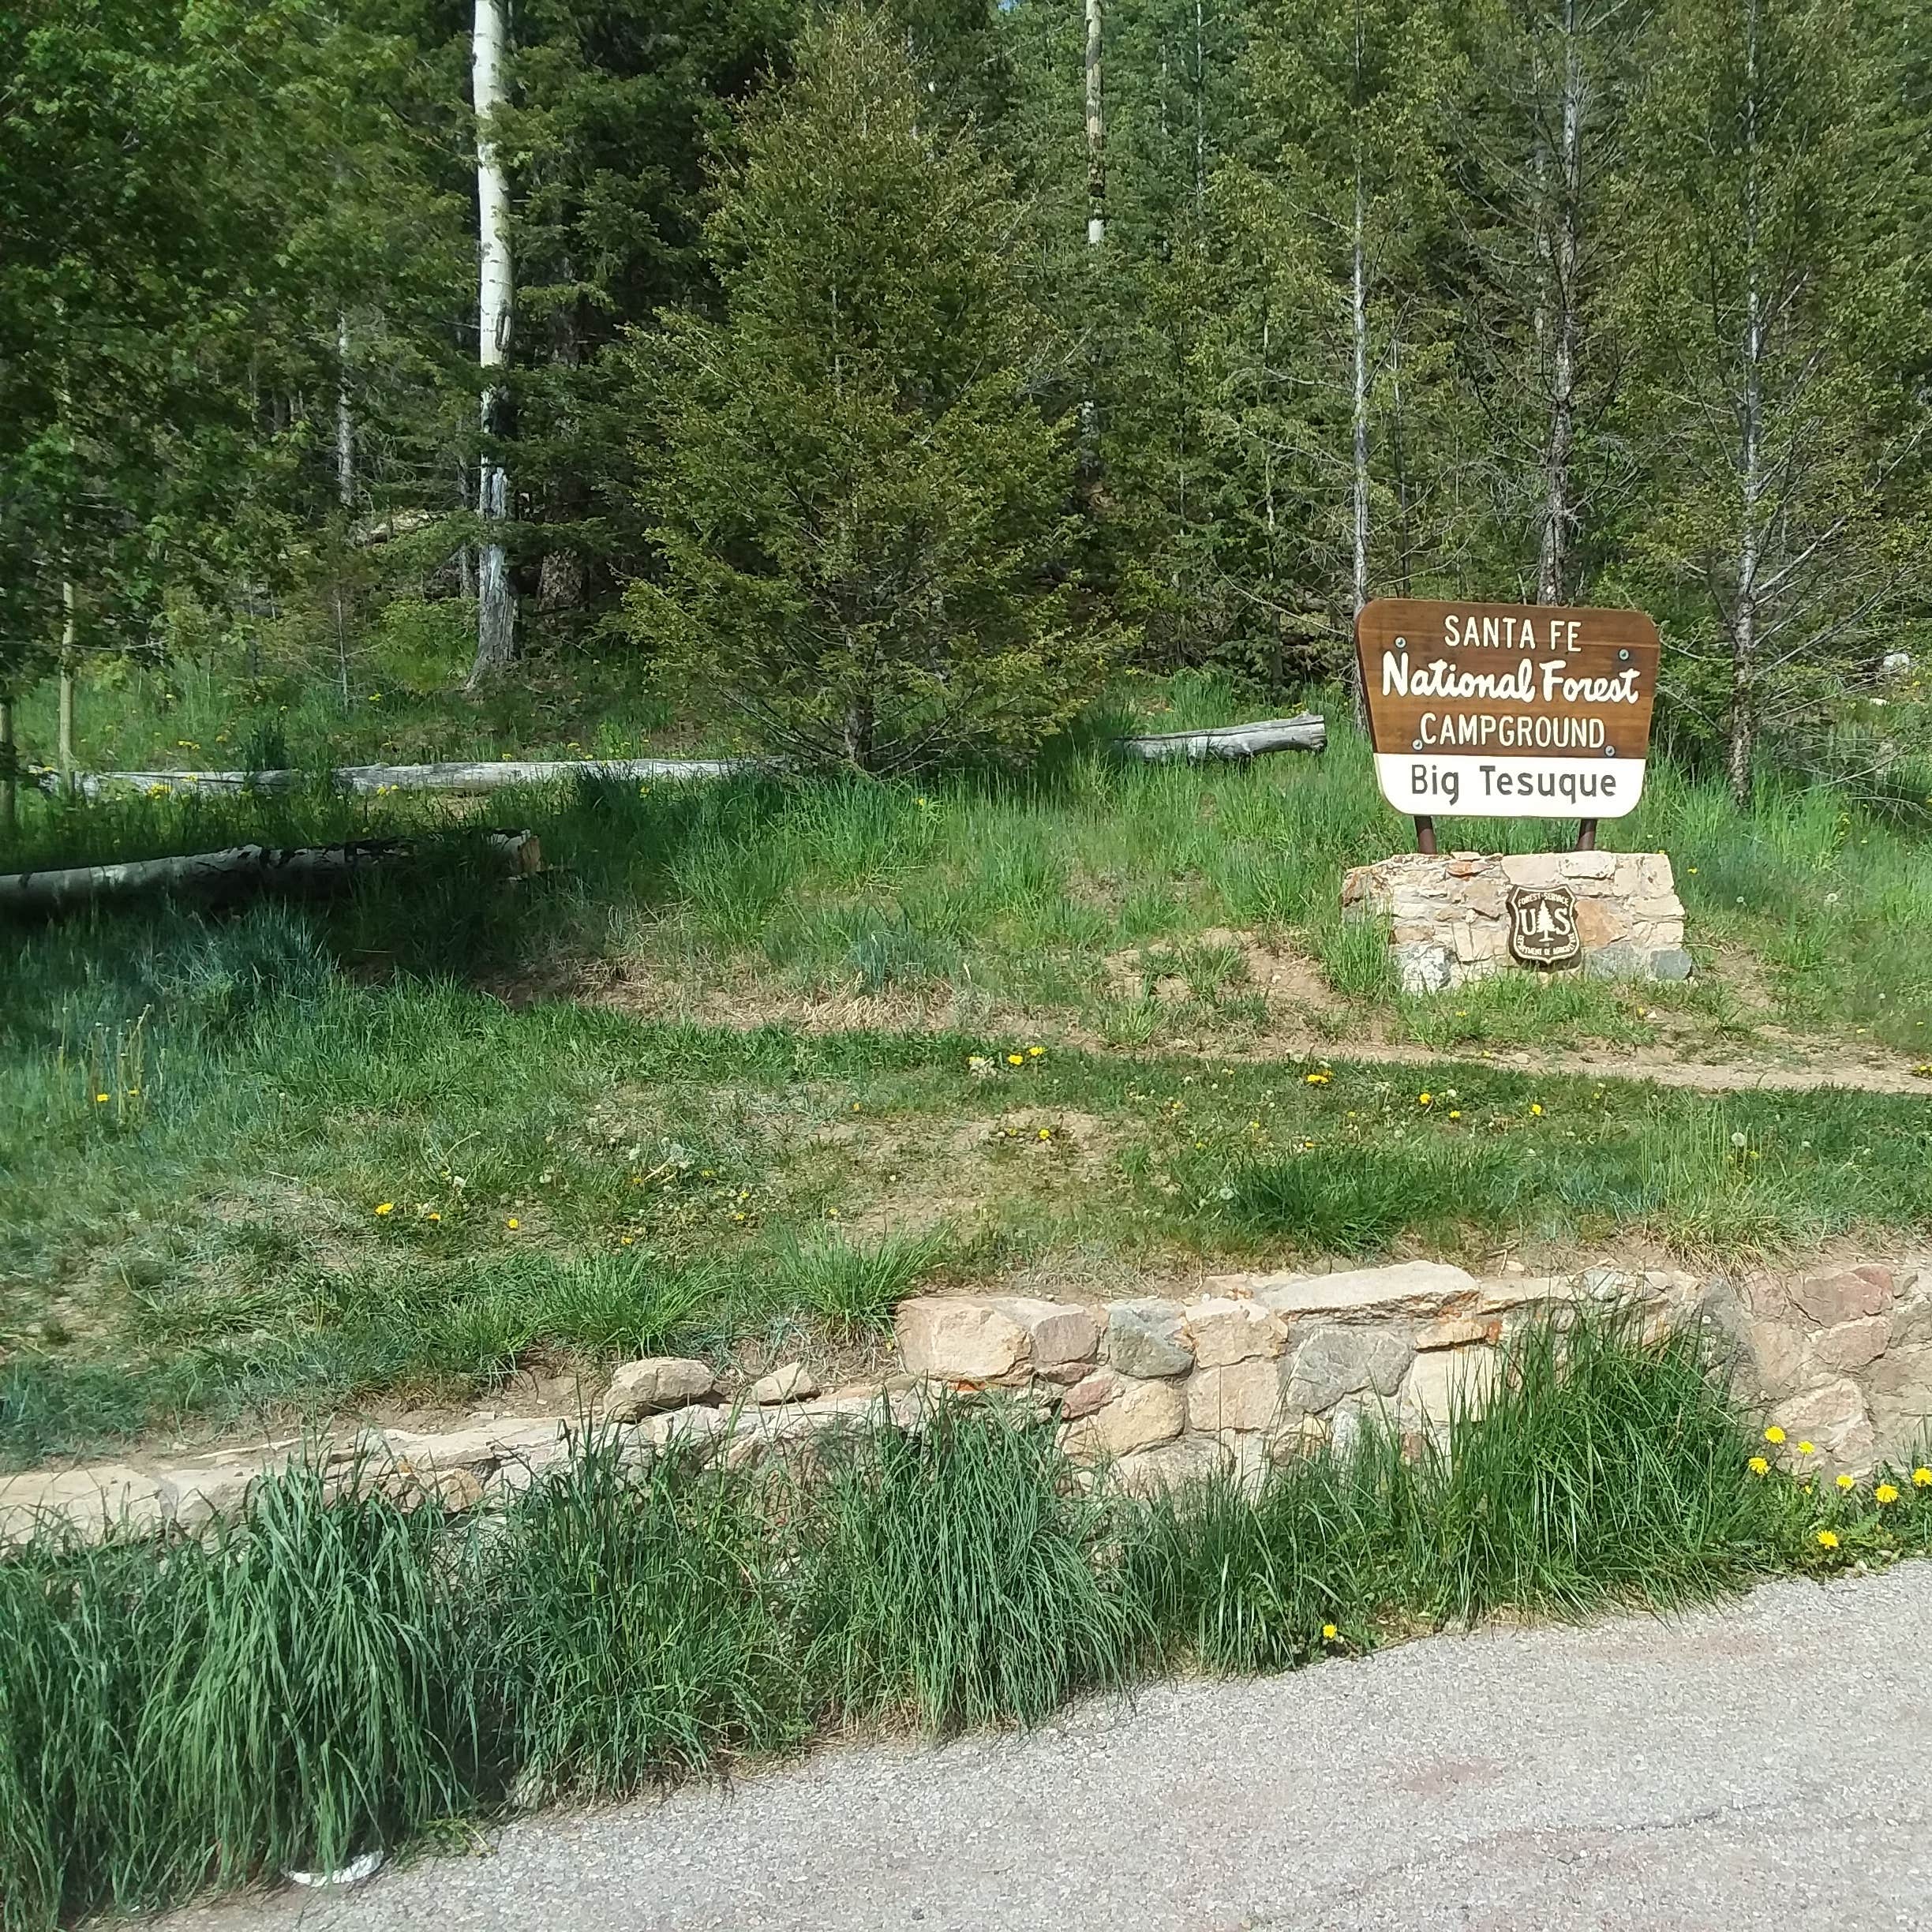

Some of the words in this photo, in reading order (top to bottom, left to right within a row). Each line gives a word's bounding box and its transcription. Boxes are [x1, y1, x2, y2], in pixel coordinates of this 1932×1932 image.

[1443, 614, 1536, 650] SANTA
[1549, 620, 1582, 652] FE
[1382, 650, 1536, 703] National
[1539, 660, 1641, 704] Forest
[1420, 712, 1605, 749] CAMPGROUND
[1411, 764, 1459, 805] Big
[1479, 766, 1616, 804] Tesuque
[1518, 892, 1541, 908] FOREST
[1543, 892, 1569, 907] SERVICE
